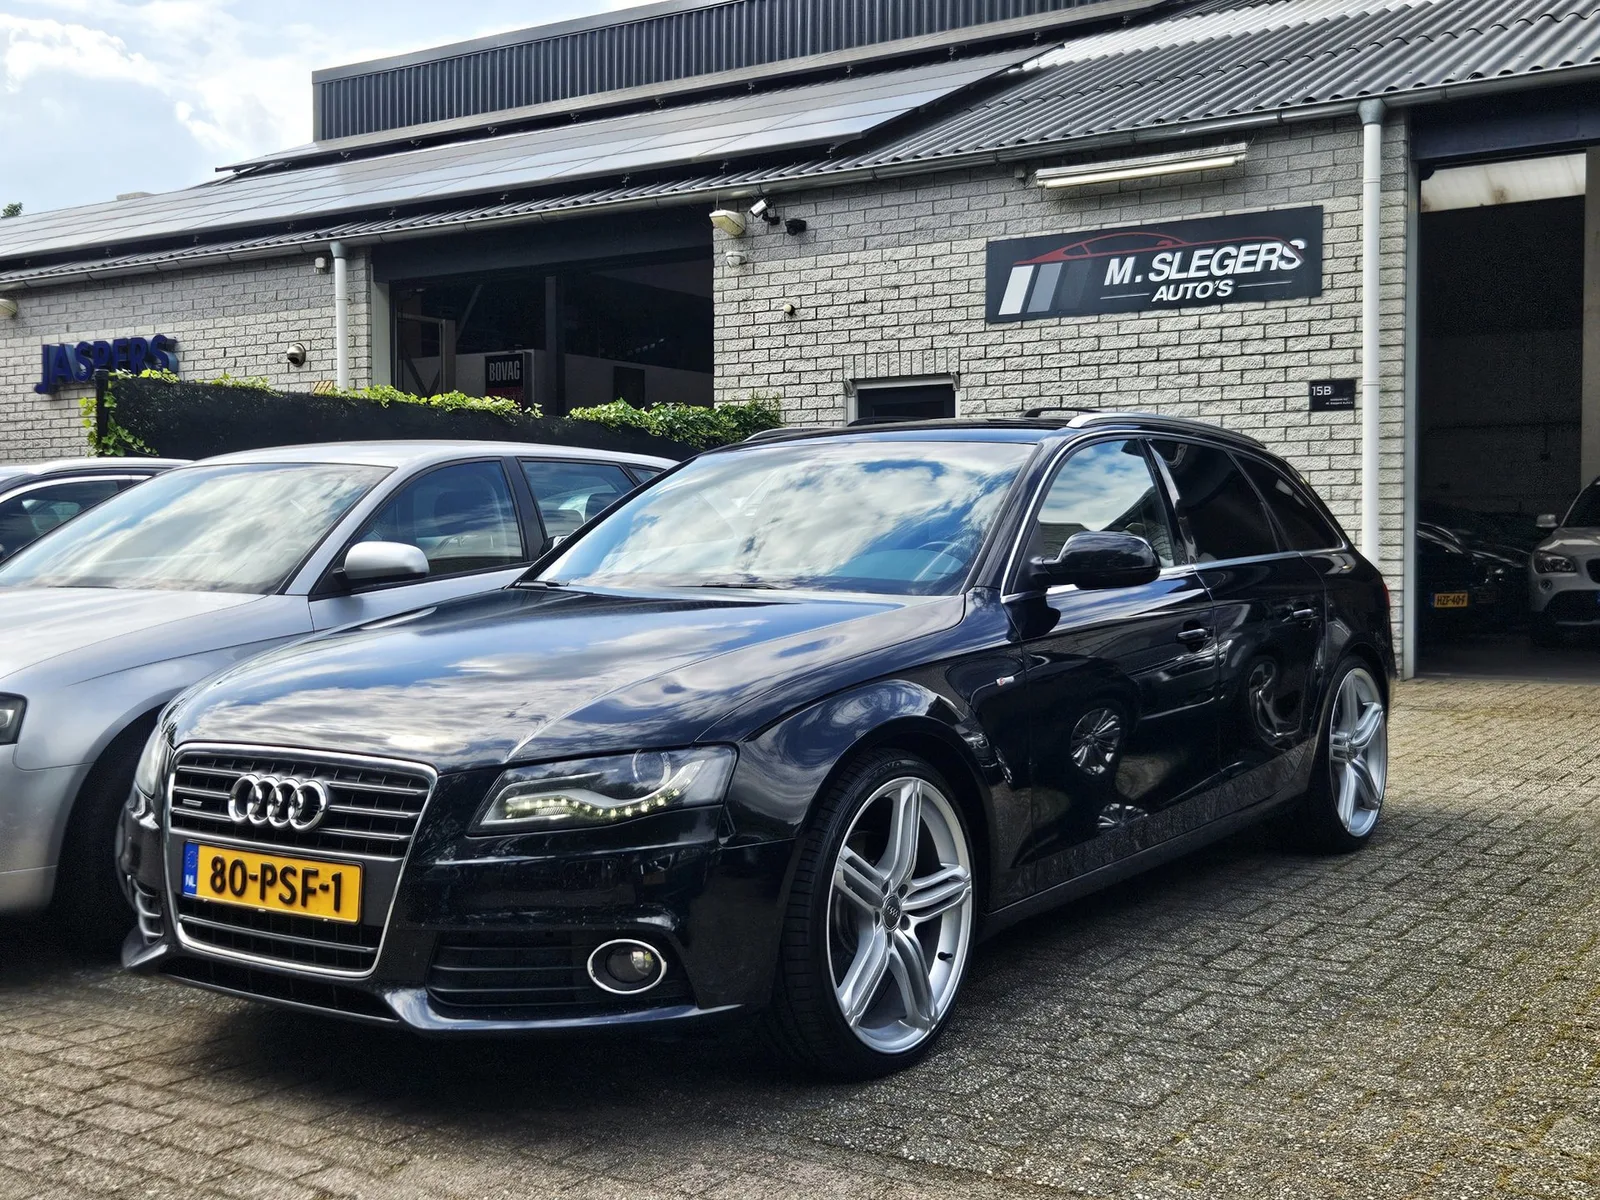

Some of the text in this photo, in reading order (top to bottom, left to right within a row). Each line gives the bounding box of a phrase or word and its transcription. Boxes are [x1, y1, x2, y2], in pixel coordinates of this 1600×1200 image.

[1148, 239, 1307, 282] SLEGERS
[1151, 279, 1235, 303] AUTO'S
[34, 334, 178, 394] JASPERS
[489, 360, 520, 382] BOVAG
[1311, 385, 1332, 396] 15B
[184, 874, 197, 887] NL
[210, 855, 342, 913] 80-PSF-1
